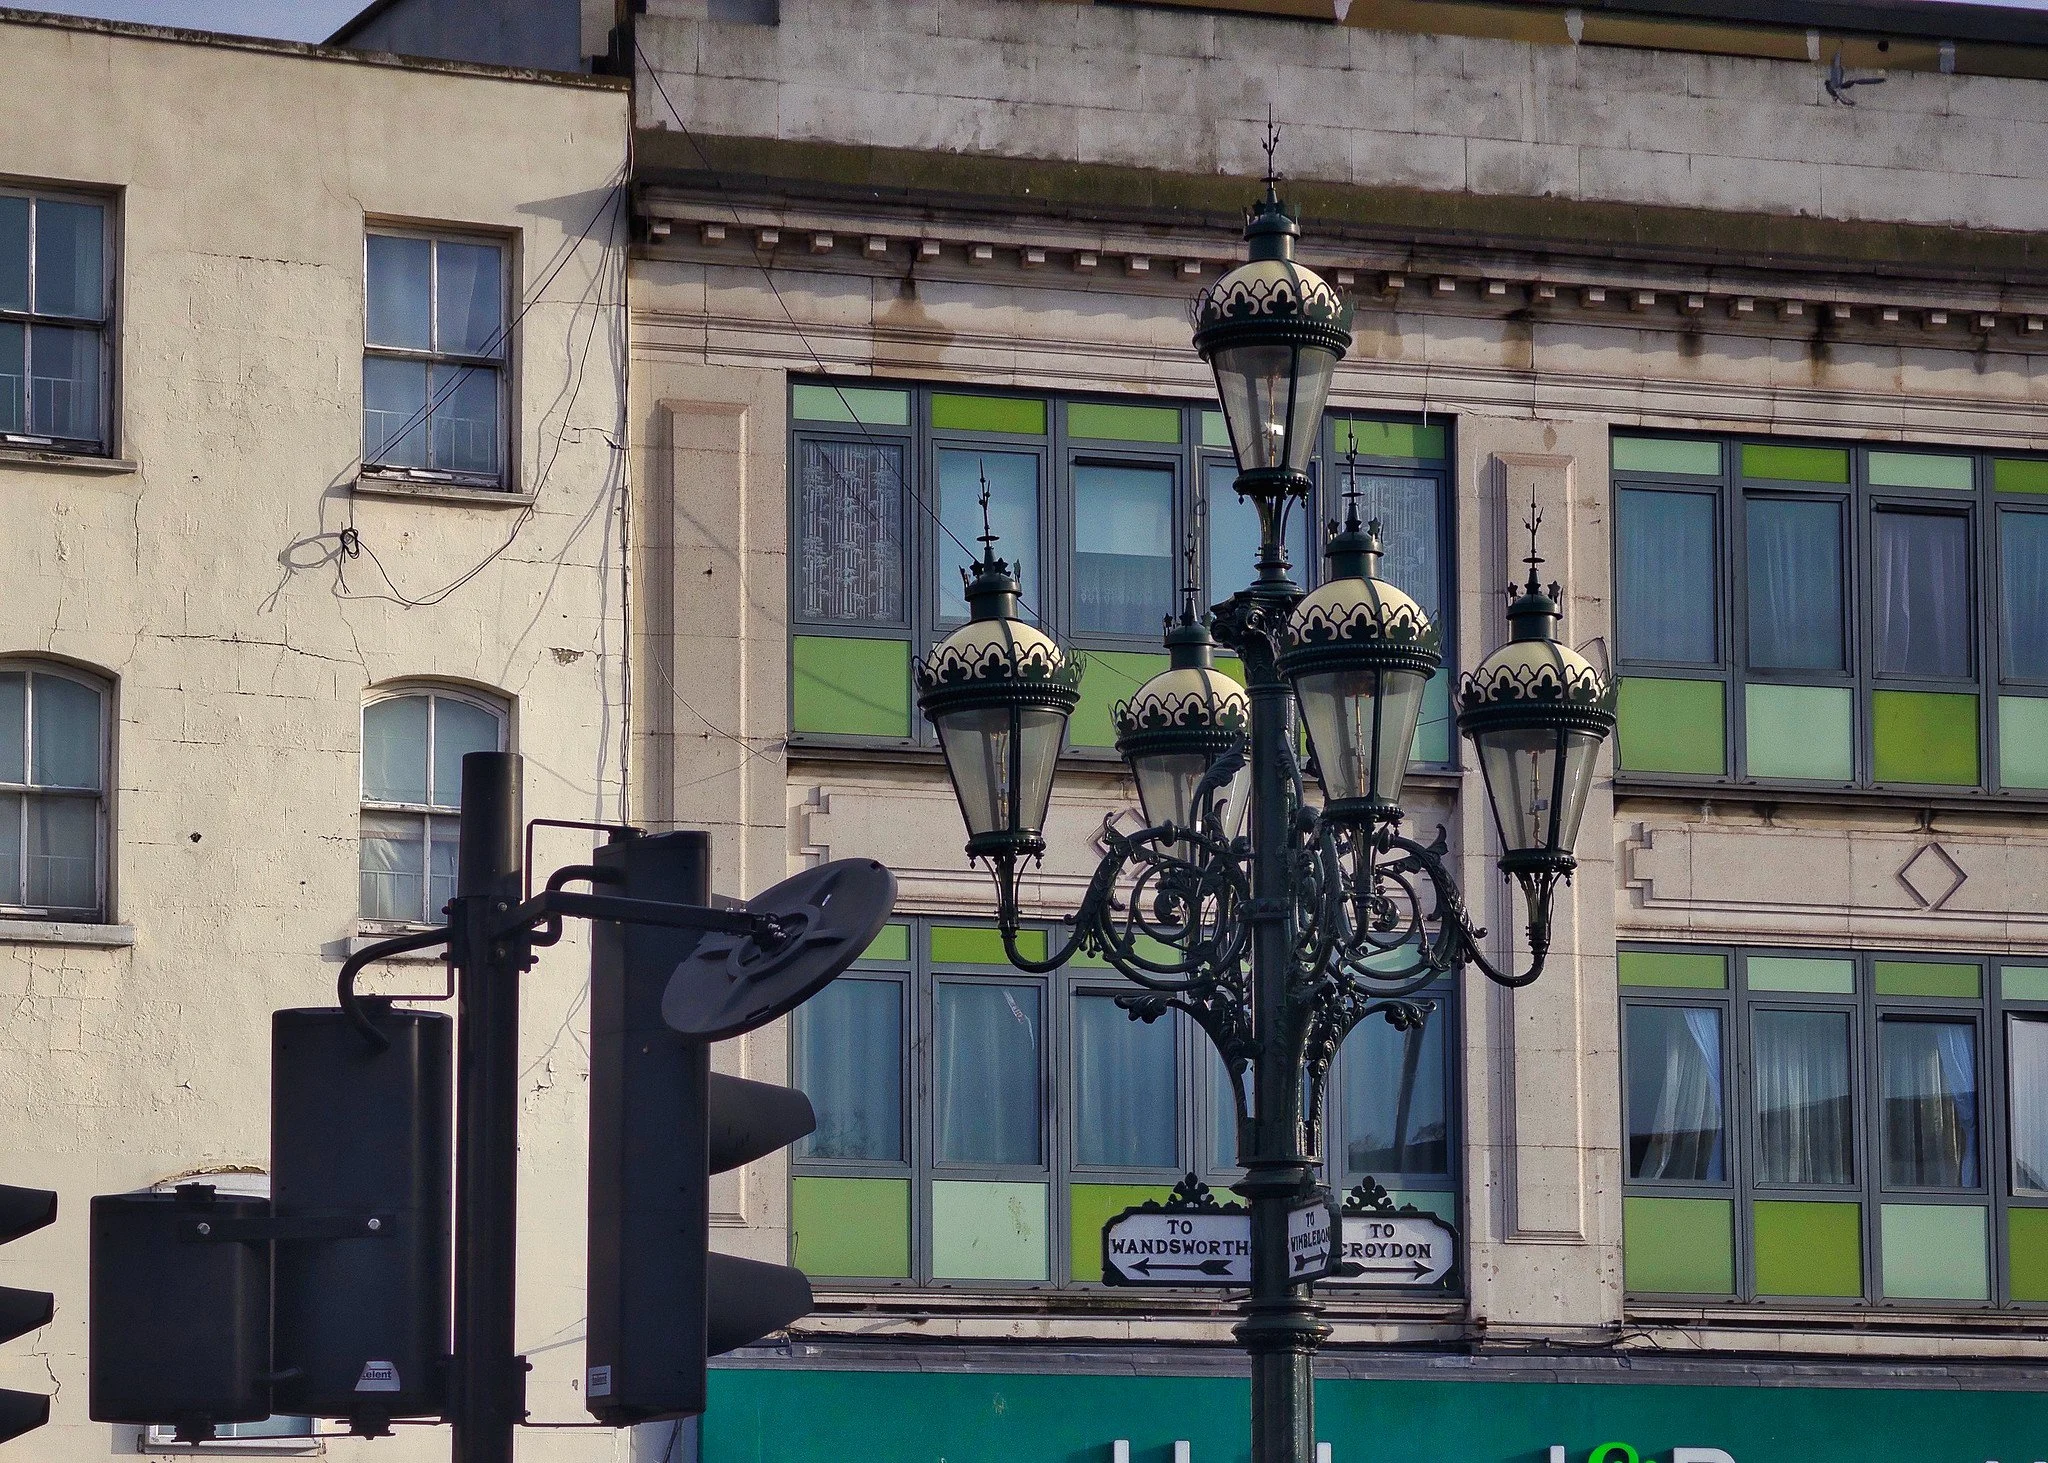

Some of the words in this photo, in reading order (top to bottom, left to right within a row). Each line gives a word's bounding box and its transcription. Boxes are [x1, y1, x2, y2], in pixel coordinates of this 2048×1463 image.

[1167, 1219, 1193, 1235] TO
[1305, 1211, 1315, 1228] TO
[1370, 1223, 1395, 1238] TO
[1110, 1238, 1250, 1256] WANDSWORTH
[1290, 1226, 1331, 1253] WIMBLEDON
[361, 1370, 392, 1379] elent
